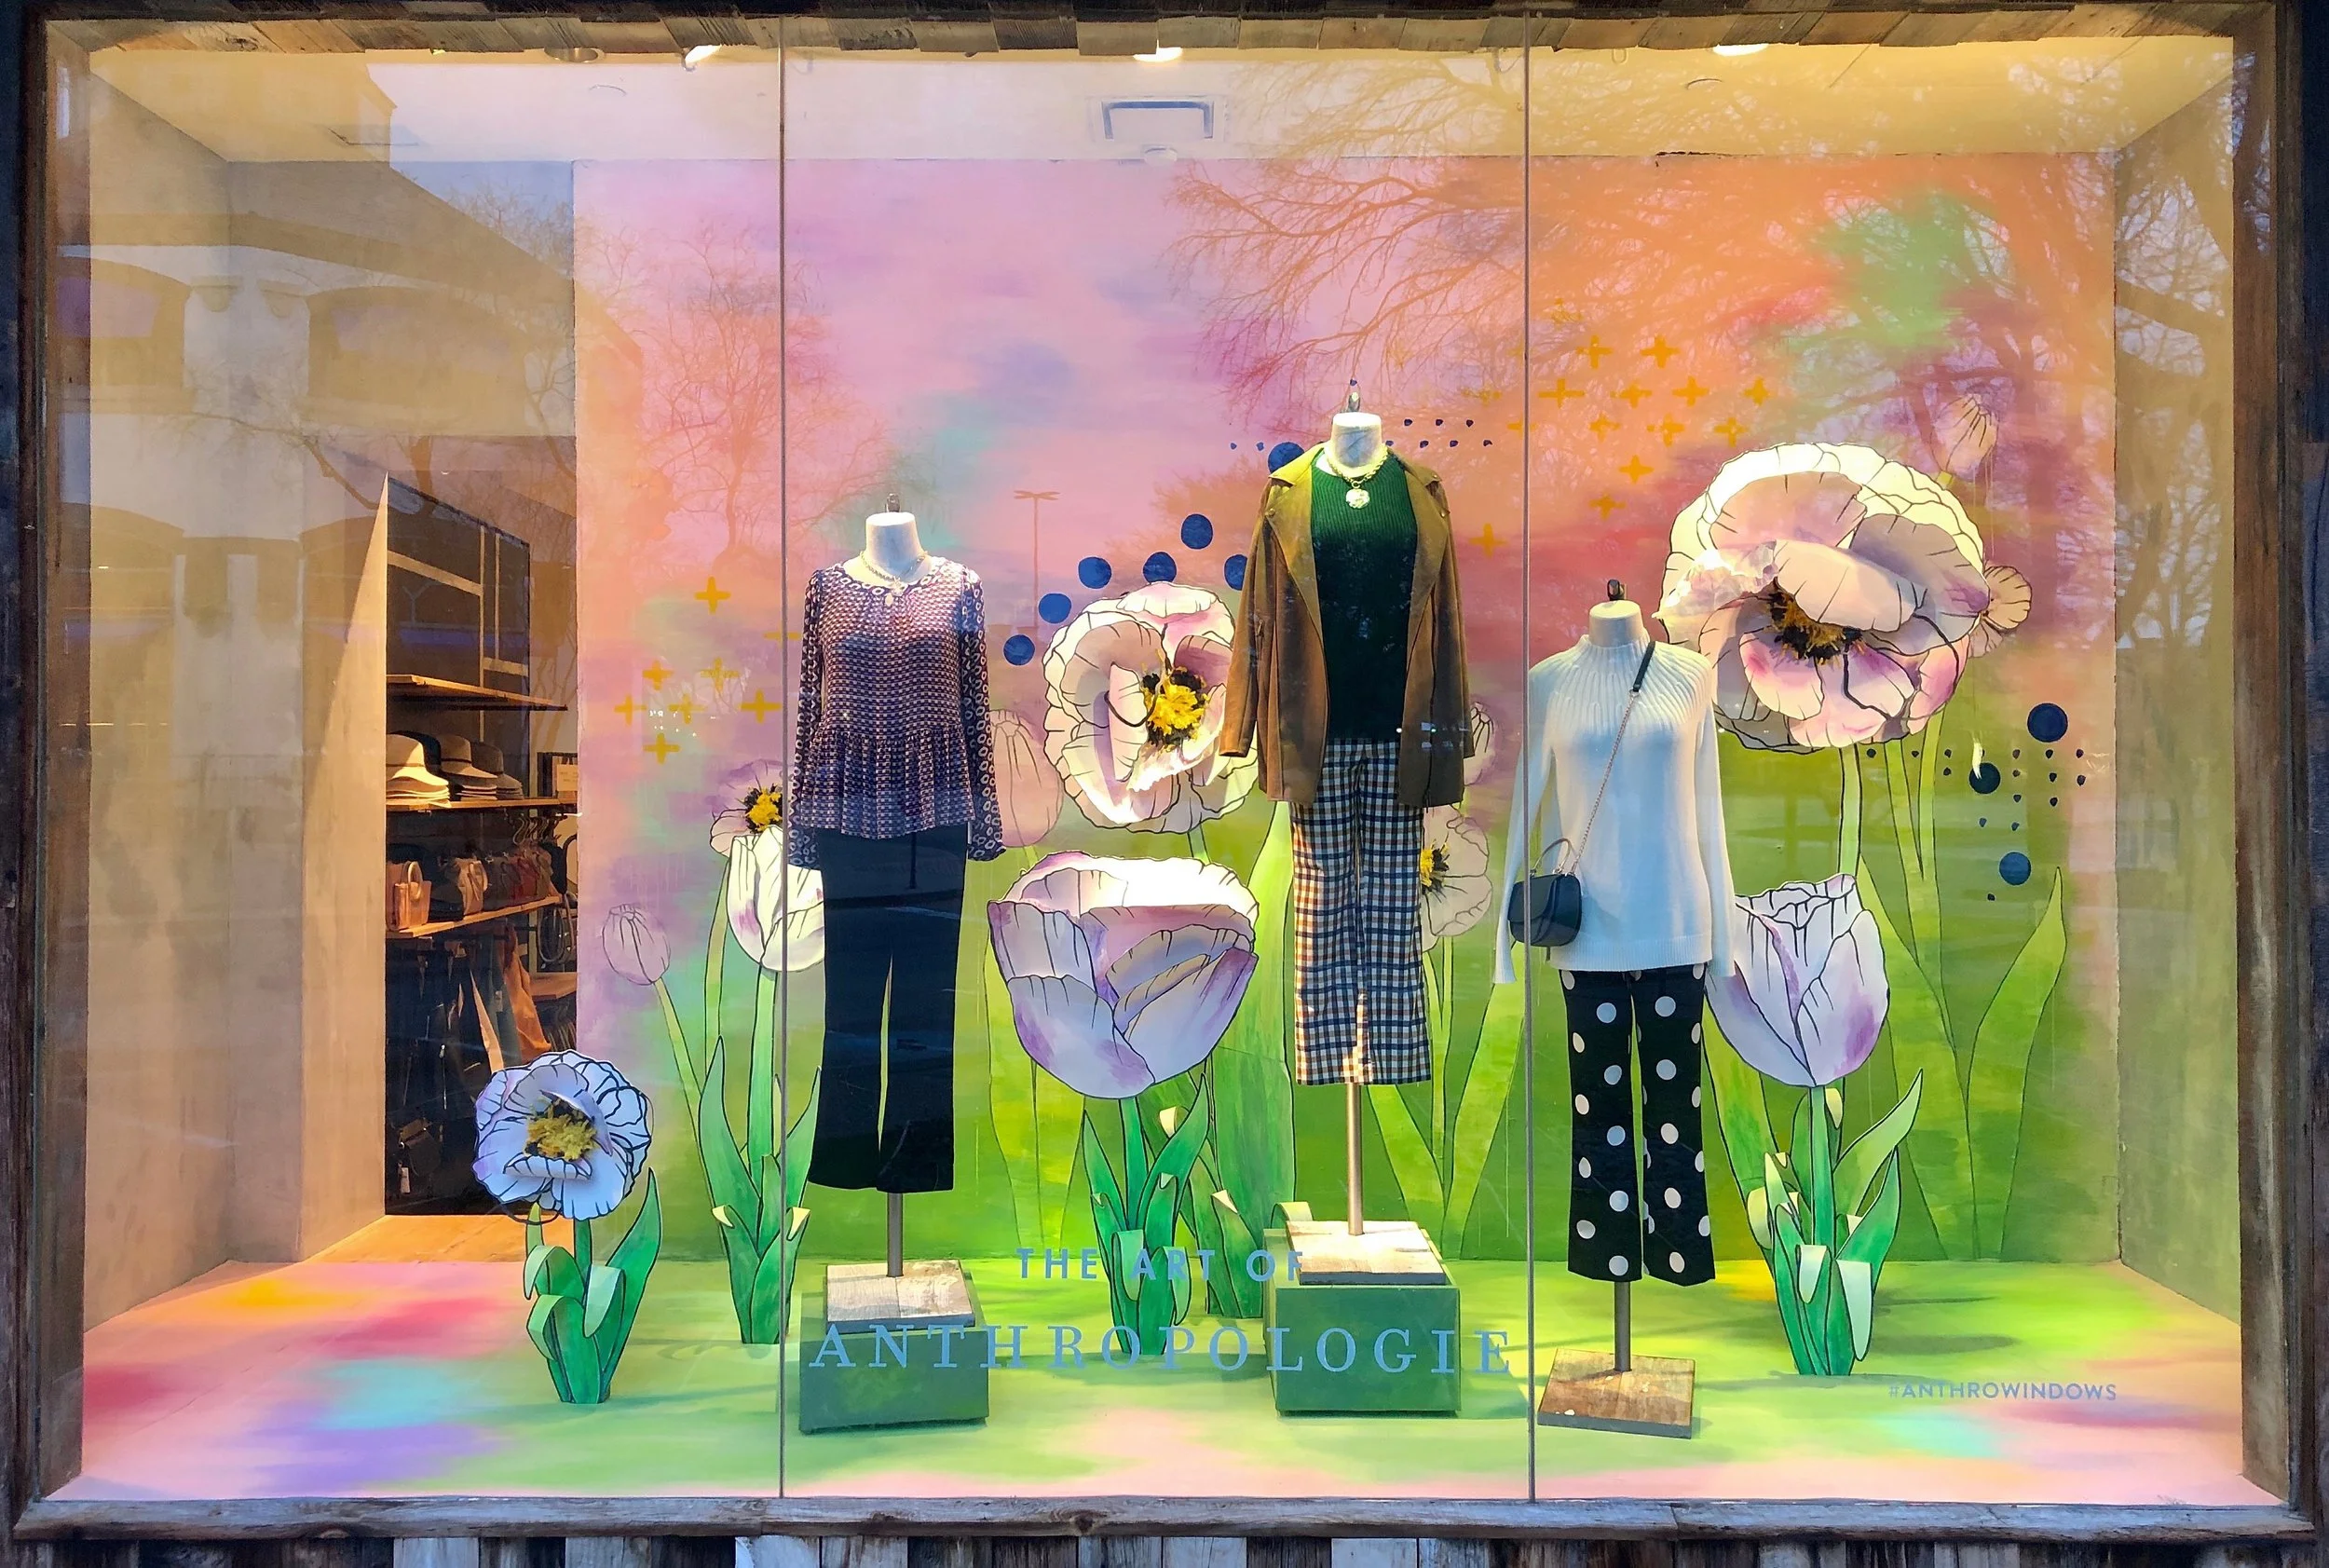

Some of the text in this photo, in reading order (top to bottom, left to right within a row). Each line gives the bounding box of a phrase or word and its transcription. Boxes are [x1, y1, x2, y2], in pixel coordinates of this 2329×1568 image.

[1016, 1248, 1303, 1282] THE ART OF
[808, 1323, 1510, 1374] ANTHROPOLOGIE
[1888, 1382, 2117, 1400] #ANTHROWINDOWS
